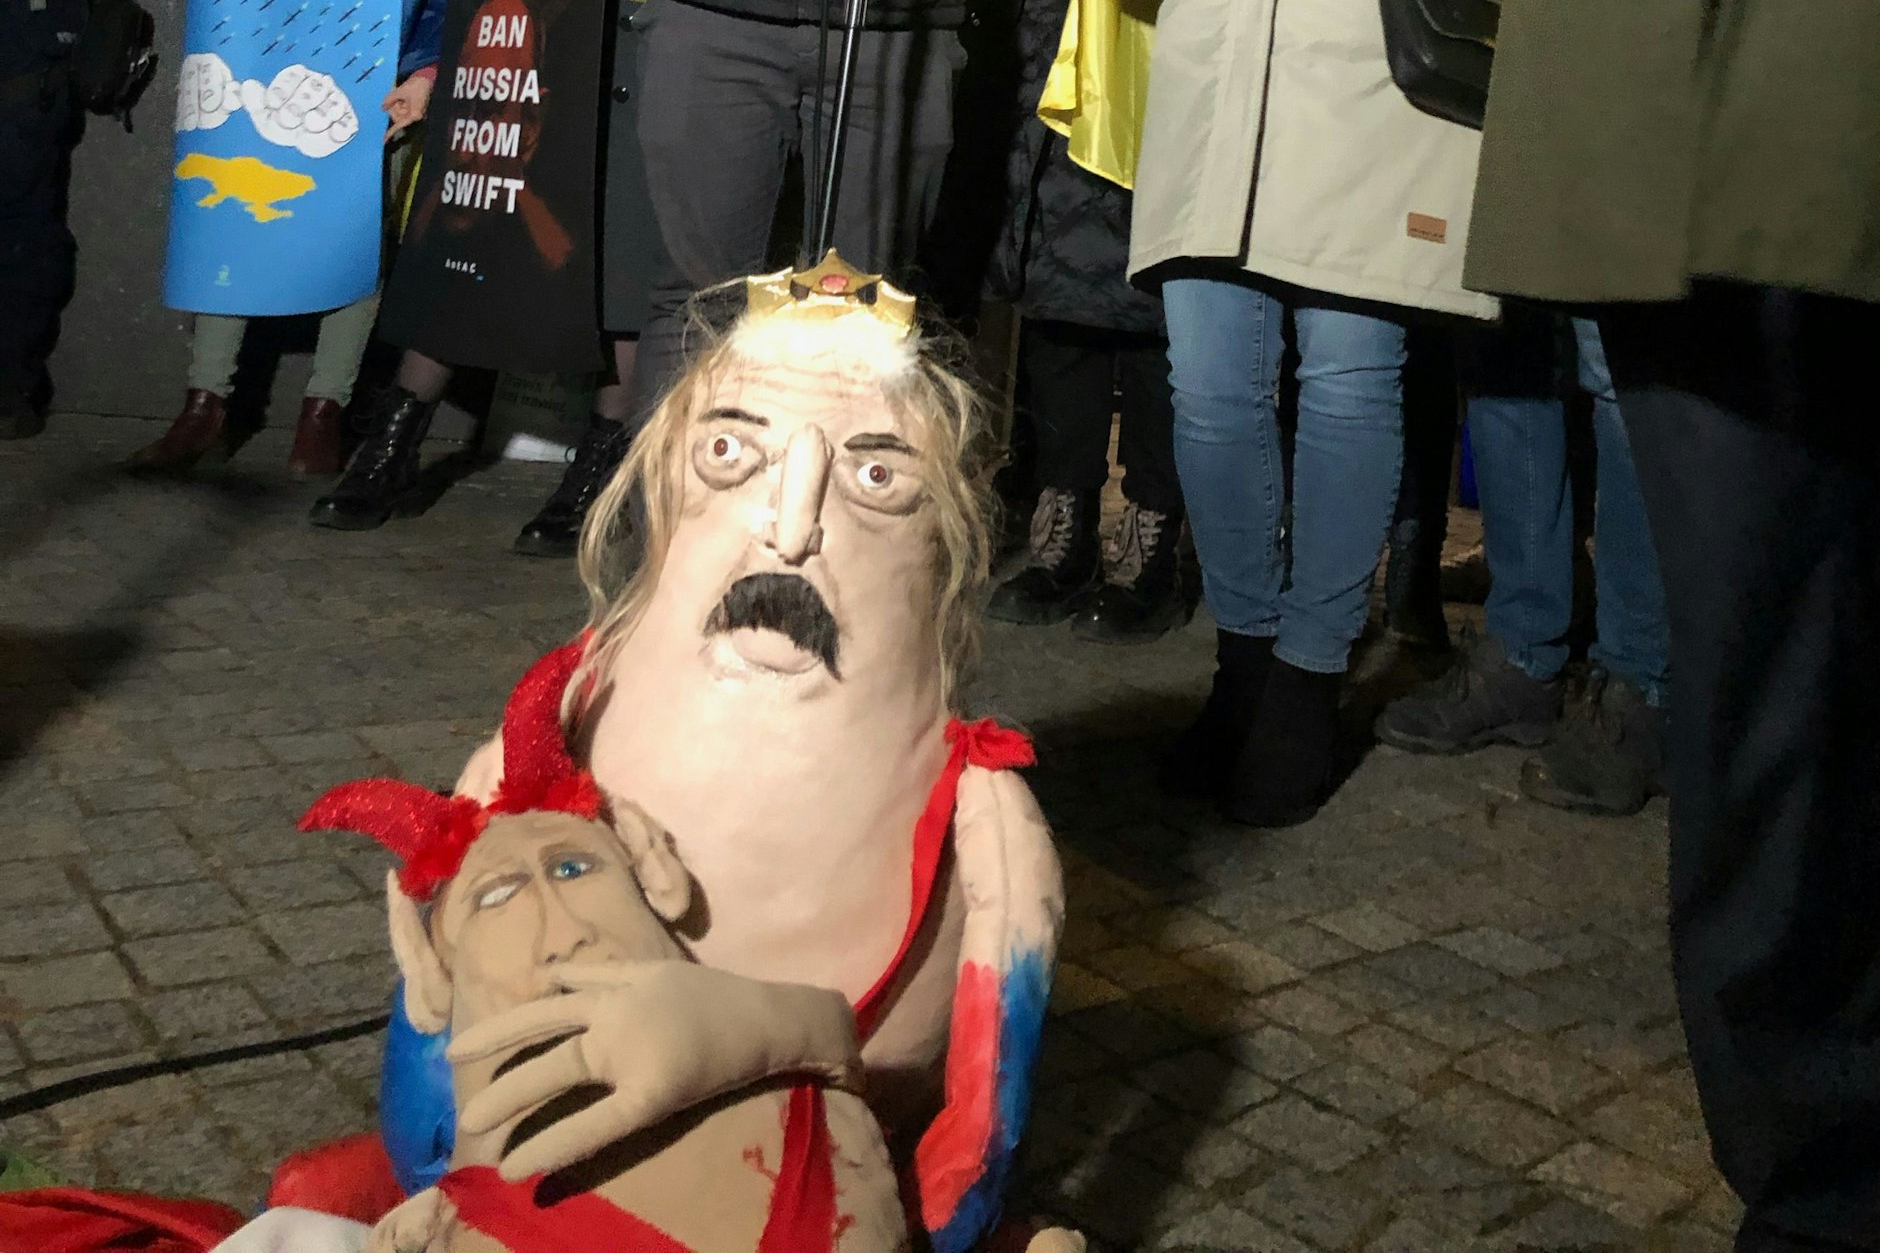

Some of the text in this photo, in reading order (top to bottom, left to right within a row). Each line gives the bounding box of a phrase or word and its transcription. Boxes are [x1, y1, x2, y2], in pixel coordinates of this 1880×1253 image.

[477, 14, 528, 48] BAN
[453, 66, 540, 104] RUSSIA
[451, 118, 521, 158] FROM
[441, 170, 525, 214] SWIFT
